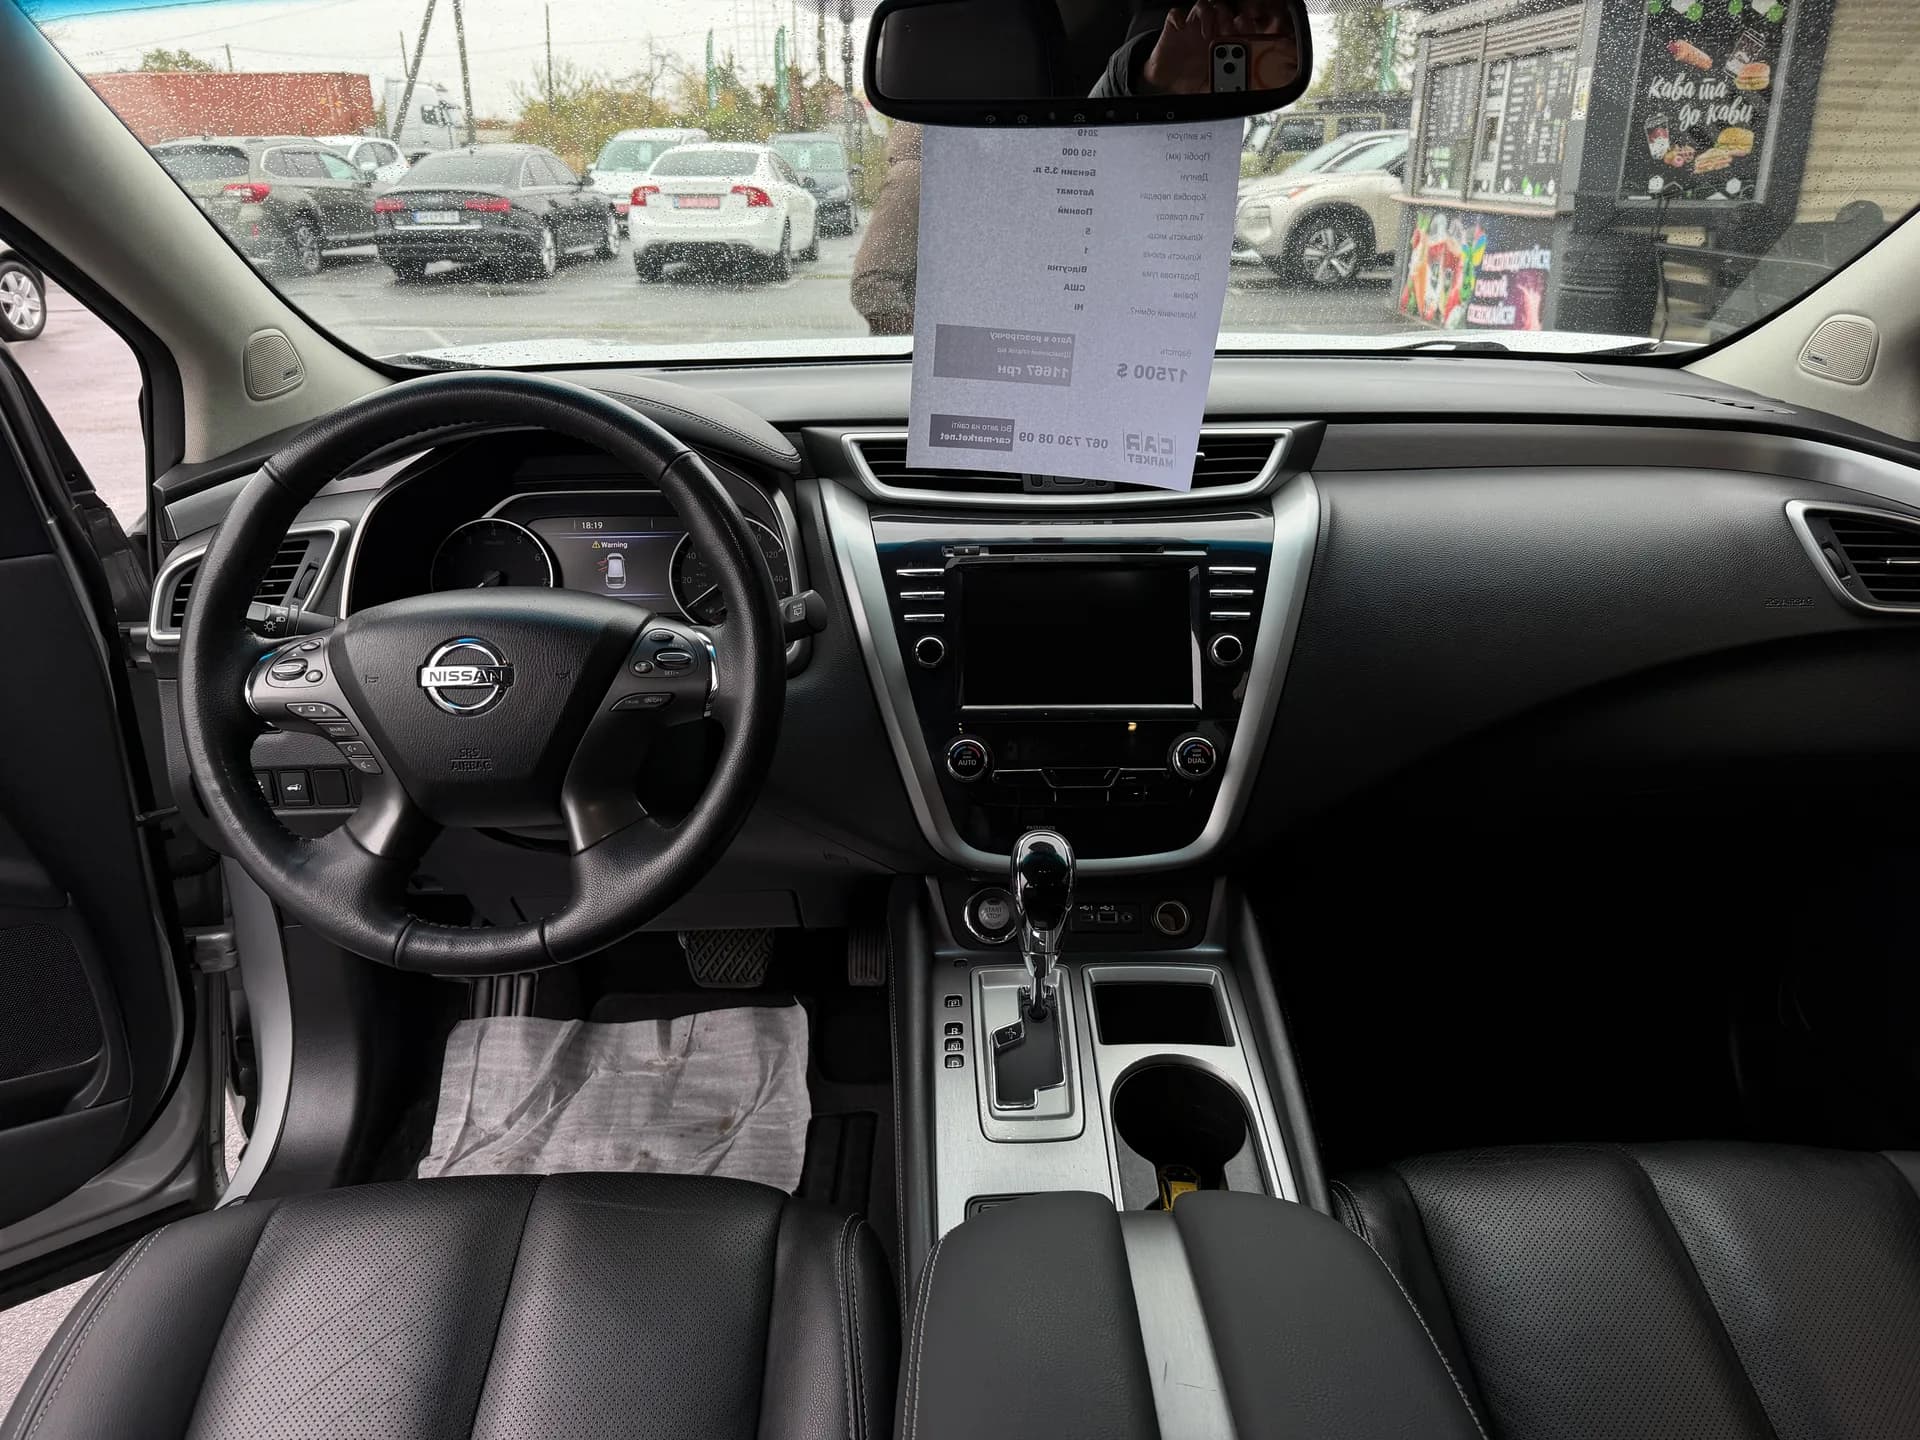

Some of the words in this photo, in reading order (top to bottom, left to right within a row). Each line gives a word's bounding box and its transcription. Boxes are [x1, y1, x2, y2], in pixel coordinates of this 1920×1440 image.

[581, 520, 603, 530] 18:19
[600, 540, 628, 550] Warning
[429, 670, 504, 683] NISSAN
